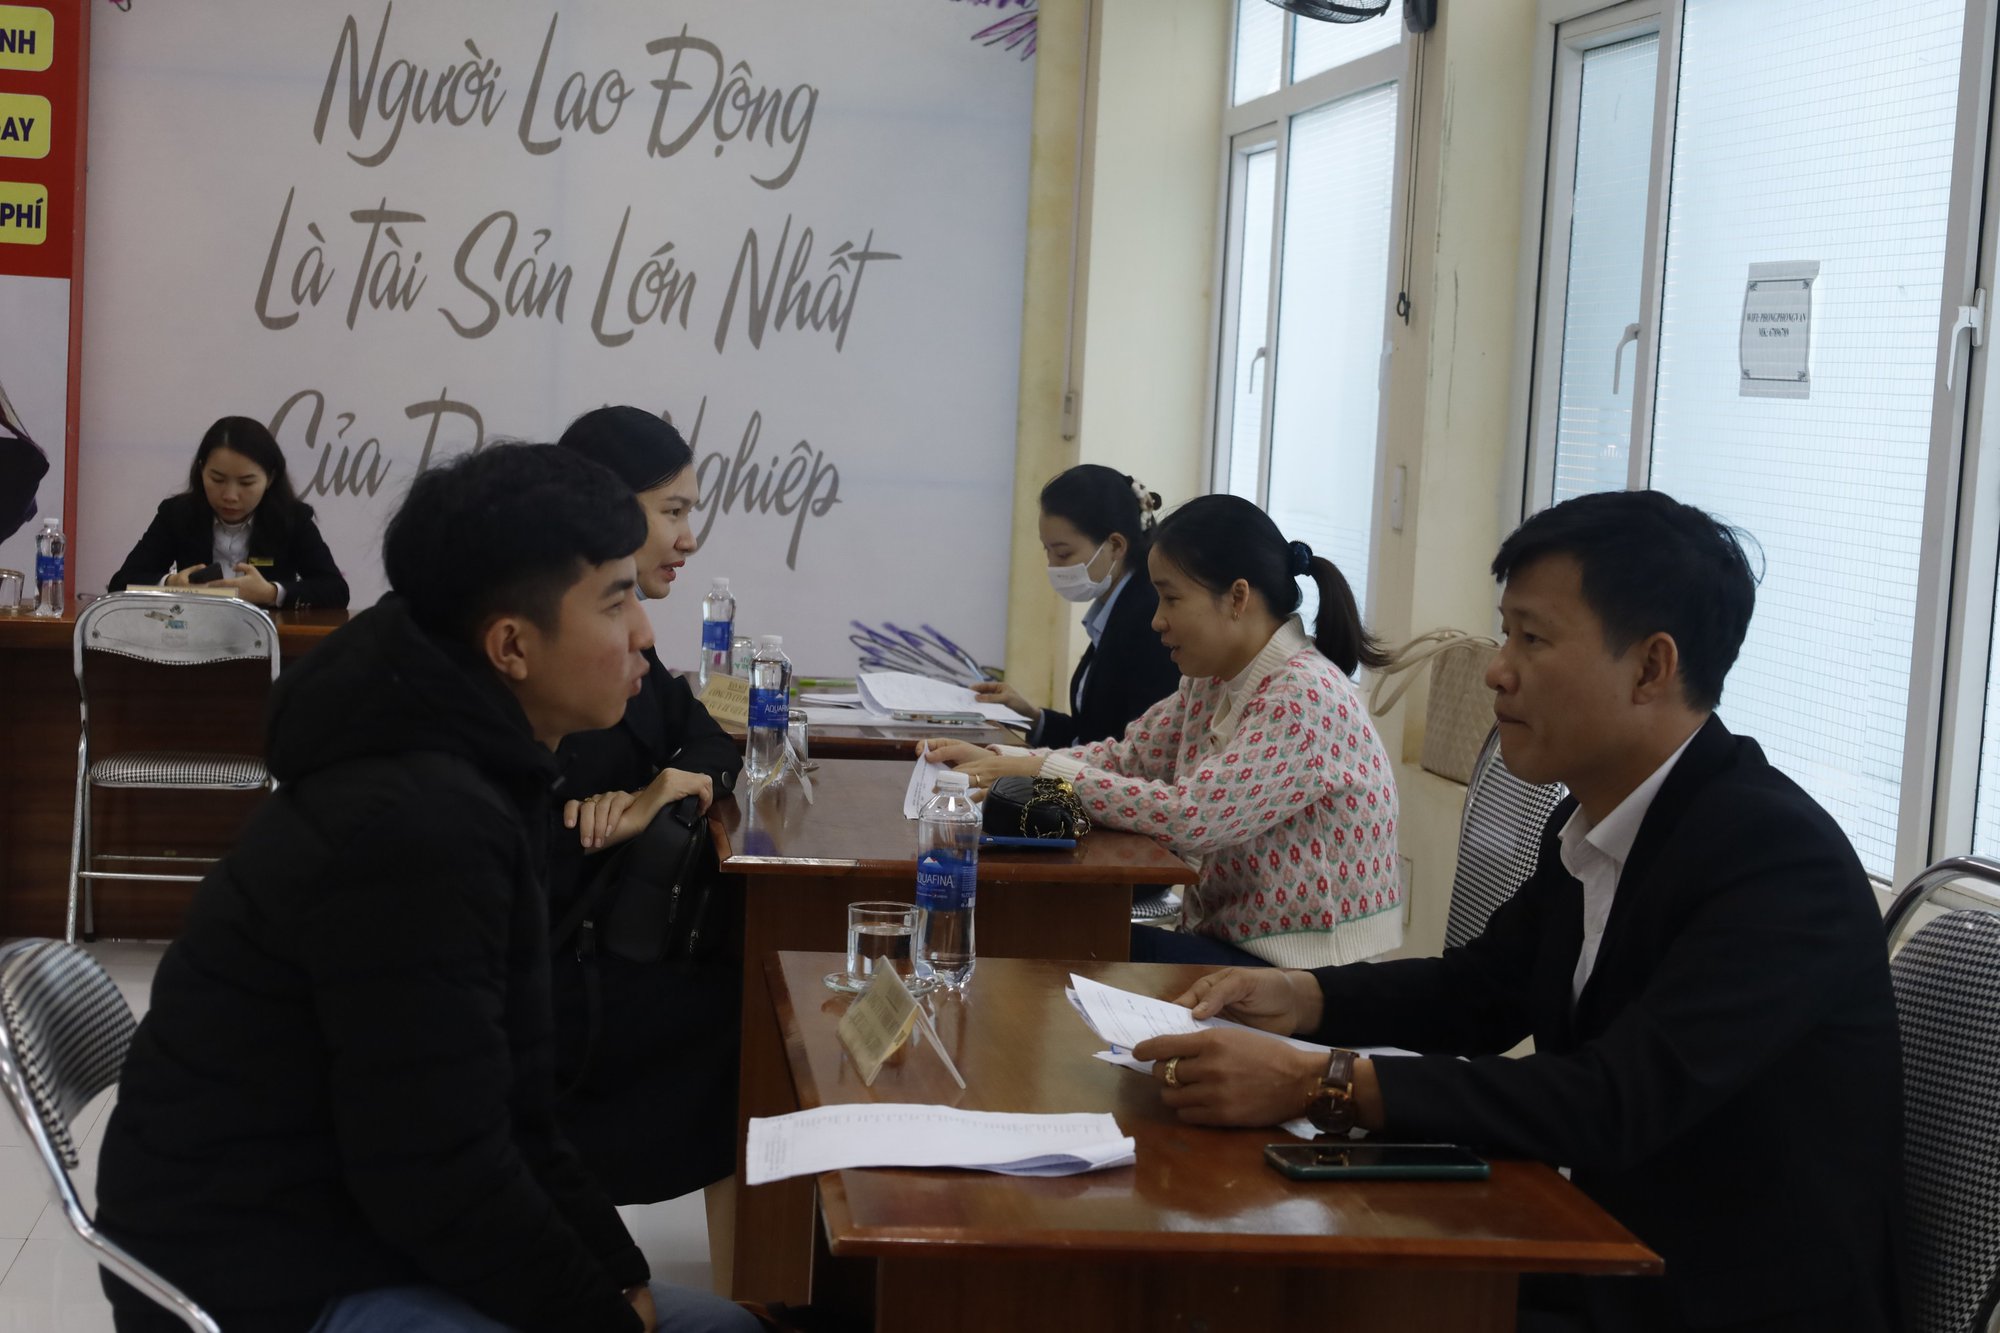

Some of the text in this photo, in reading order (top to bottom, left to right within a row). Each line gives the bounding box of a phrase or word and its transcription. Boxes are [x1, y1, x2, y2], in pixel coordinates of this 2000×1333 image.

[0, 116, 35, 142] AY
[313, 0, 819, 190] Người Lao Động
[0, 197, 44, 229] PHÍ
[255, 186, 902, 354] Là Tài Sản Lớn Nhất
[268, 389, 392, 500] Của
[917, 871, 955, 889] QUAFINA
